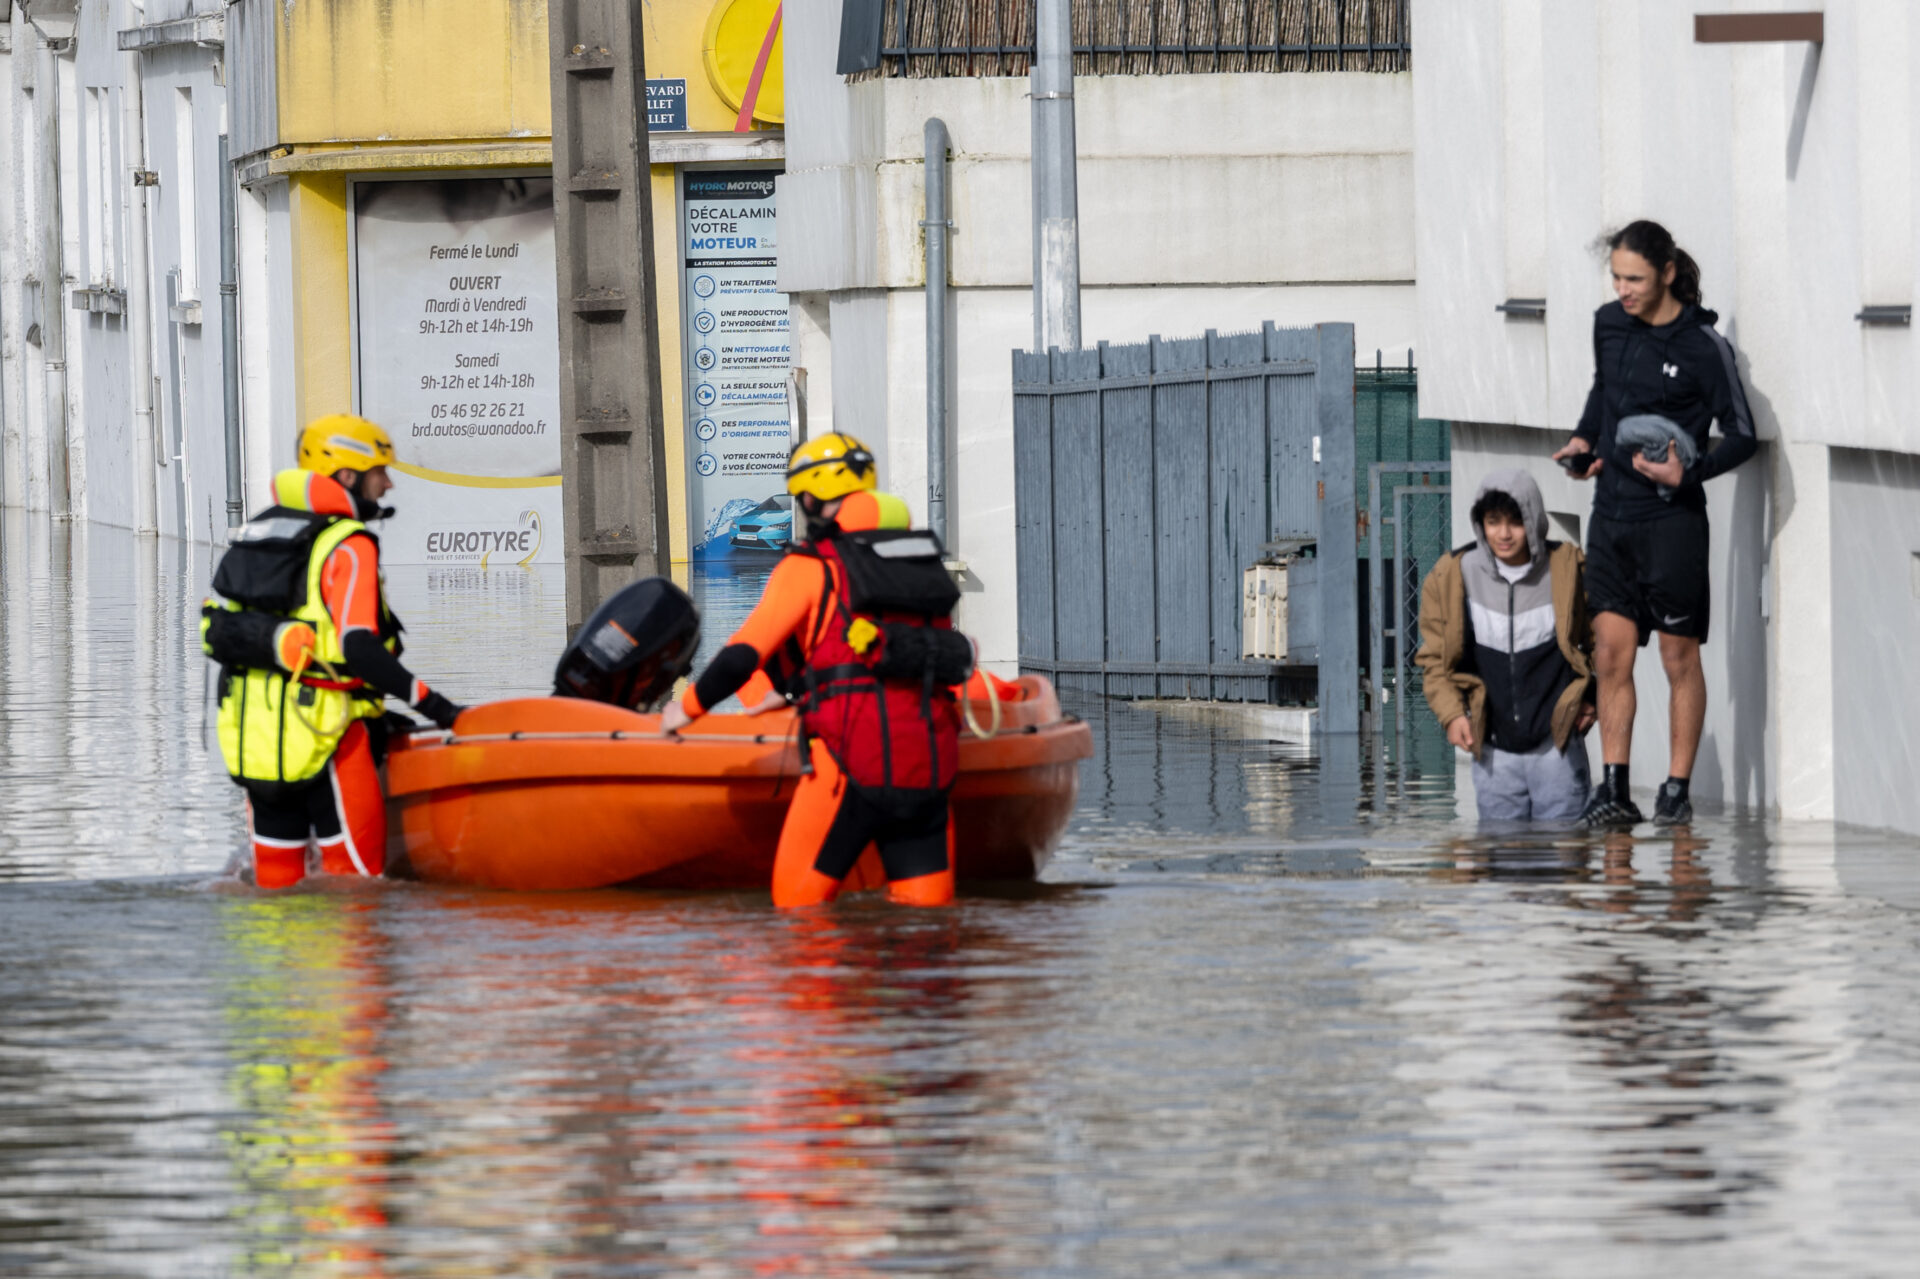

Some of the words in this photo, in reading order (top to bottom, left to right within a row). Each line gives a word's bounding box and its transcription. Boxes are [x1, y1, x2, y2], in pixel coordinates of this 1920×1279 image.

[690, 206, 776, 219] DÉCALAMIN
[691, 223, 737, 233] VOTRE
[691, 237, 756, 249] MOTEUR
[430, 244, 468, 259] Fermé
[471, 244, 482, 258] le
[486, 243, 519, 258] Lundi
[450, 276, 502, 290] OUVERT
[425, 298, 460, 312] Mardi
[462, 299, 470, 312] à
[474, 297, 527, 311] Vendredi
[419, 320, 463, 334] 9h-12h
[466, 321, 479, 333] et
[482, 318, 533, 333] 14h-19h
[455, 353, 500, 368] Samedi
[421, 375, 464, 389] 9h-12h
[468, 377, 480, 388] et
[483, 374, 535, 388] 14h-18h
[431, 404, 447, 419] 05
[450, 404, 467, 418] 46
[470, 404, 486, 418] 92
[490, 403, 506, 417] 26
[509, 403, 525, 417] 21
[412, 420, 546, 438] brd.autos@wanadoo.fr
[929, 484, 943, 499] 14
[426, 531, 531, 552] EUROTYRE
